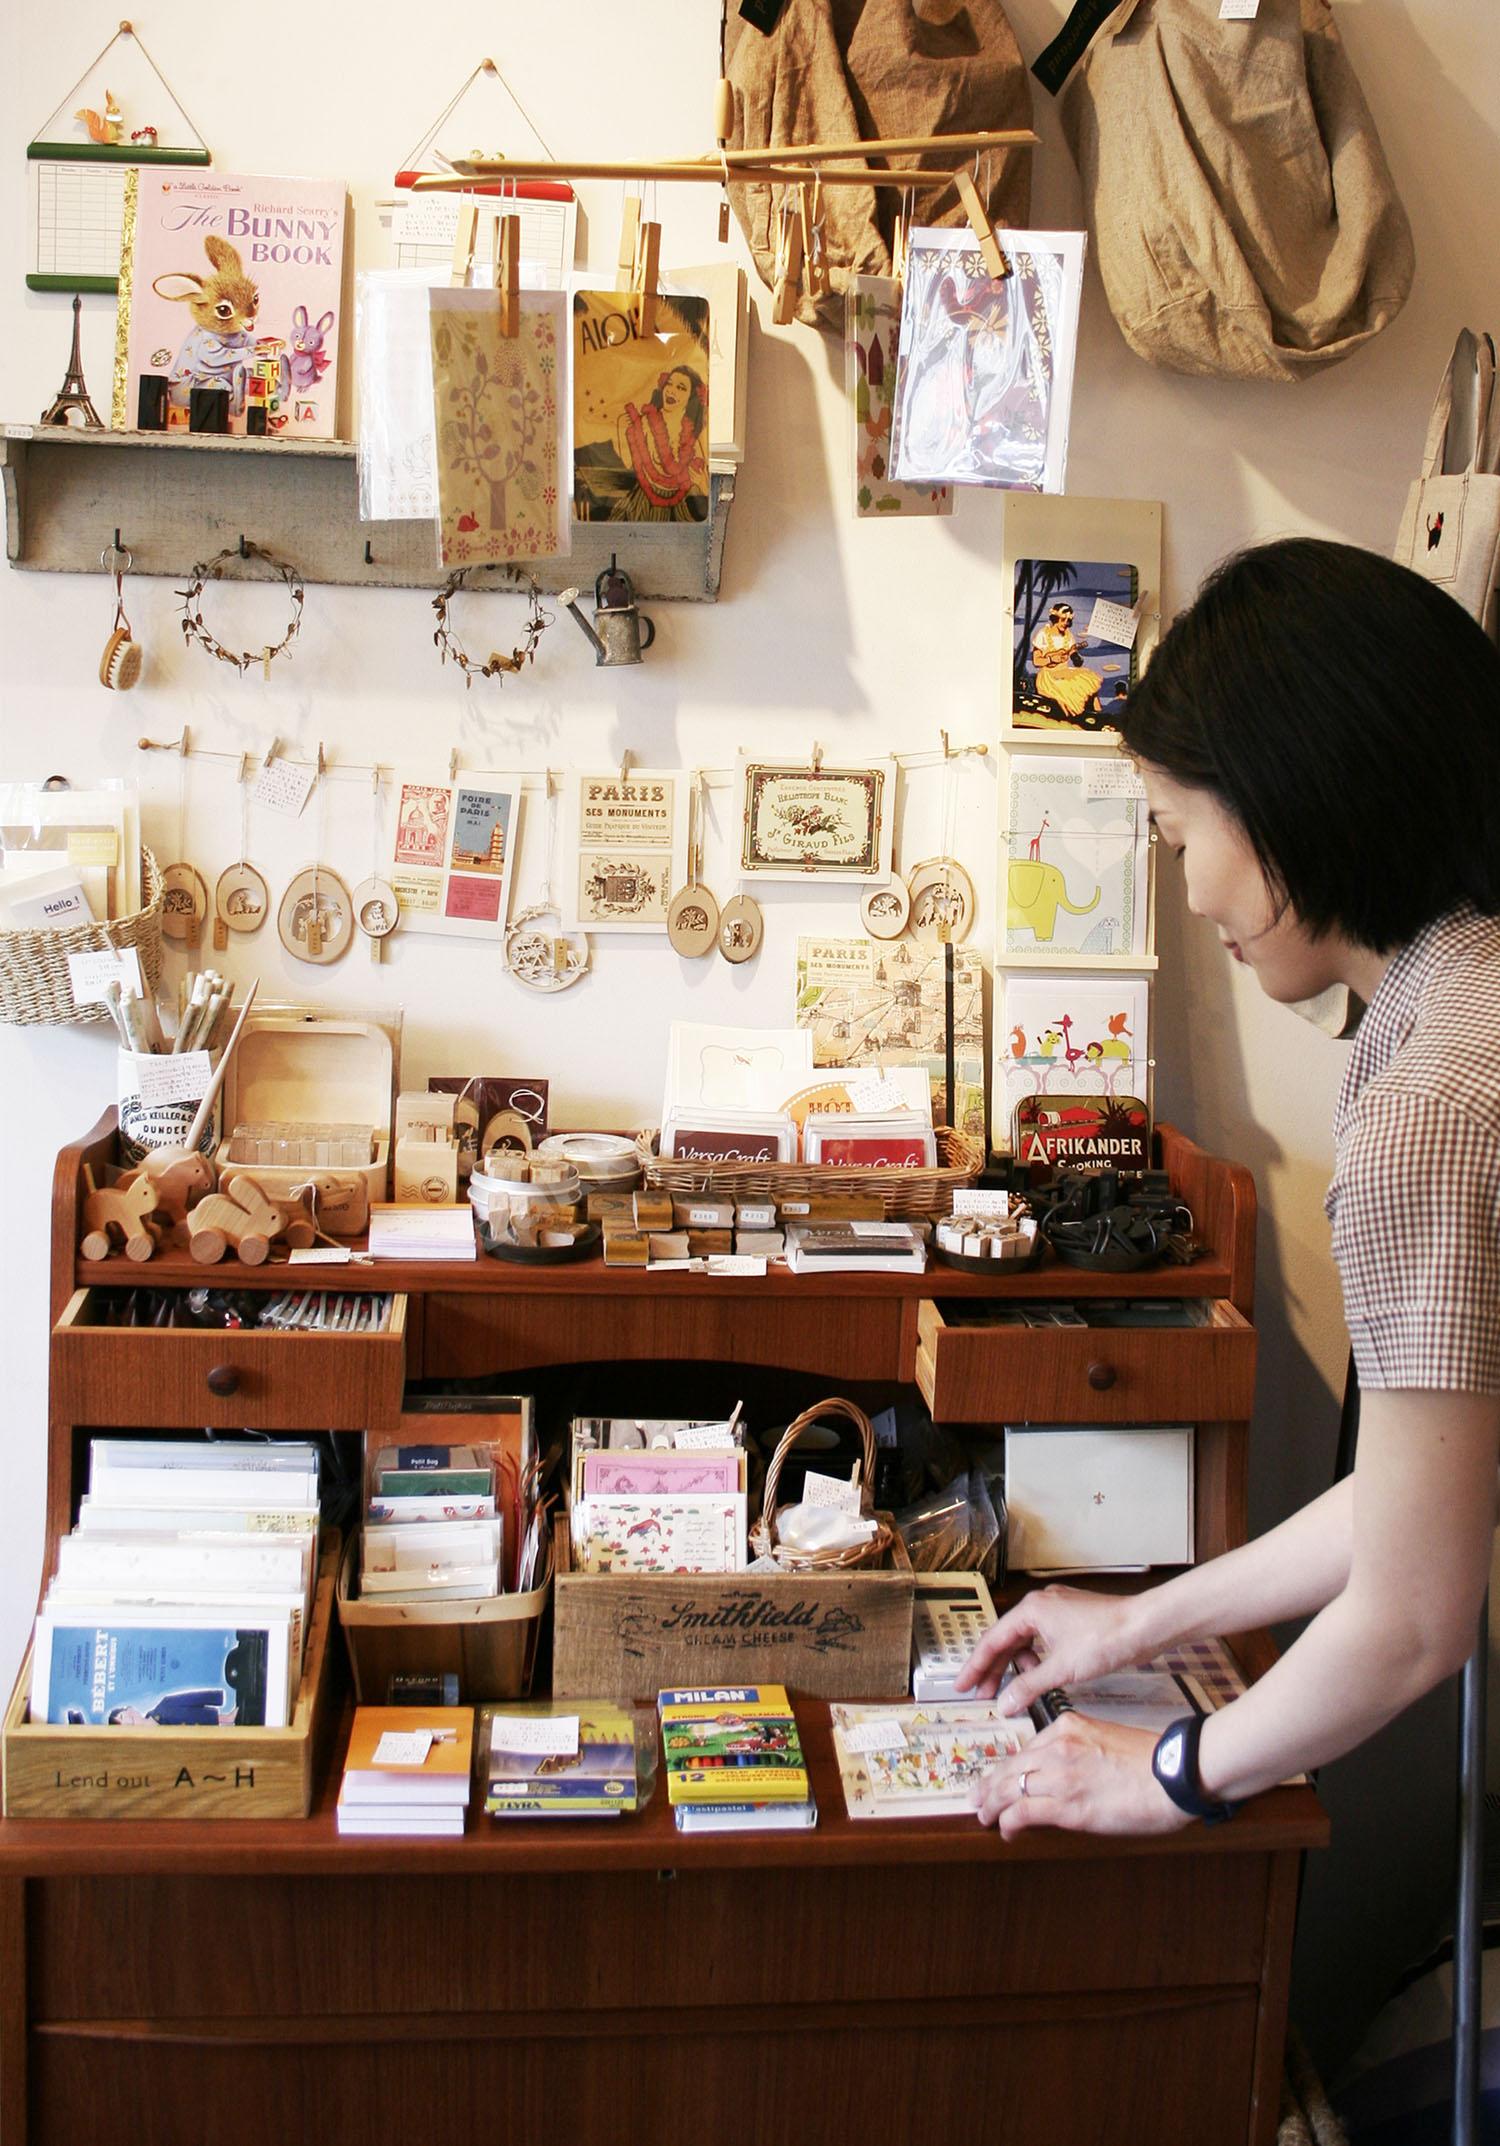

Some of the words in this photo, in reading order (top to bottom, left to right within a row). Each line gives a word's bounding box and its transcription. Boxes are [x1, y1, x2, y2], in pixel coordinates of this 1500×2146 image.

[254, 203, 294, 215] Richard
[297, 206, 338, 218] Scarry's
[161, 205, 224, 231] The
[228, 208, 337, 240] BUNNY
[252, 243, 332, 265] BOOK
[582, 307, 644, 355] ALOH
[462, 795, 492, 804] FOIRE
[587, 785, 664, 801] PARIS
[460, 808, 490, 817] PARIS
[586, 808, 603, 816] SES
[608, 808, 667, 818] MONUMENTS
[783, 833, 828, 849] GIRAUD
[832, 834, 855, 846] FILS
[43, 900, 72, 914] Hello
[812, 948, 867, 960] PARIS
[143, 1125, 187, 1135] DUNDEE
[678, 1146, 771, 1163] VersaCraft
[1027, 1132, 1142, 1165] AFRIKANDER
[1057, 1160, 1112, 1171] SOKING
[661, 1600, 819, 1629] Smithfield
[741, 1632, 796, 1646] CHEESE
[674, 1690, 746, 1703] MILAN
[56, 1771, 108, 1788] Lend
[117, 1773, 150, 1788] out
[677, 1772, 706, 1783] 12
[506, 1801, 542, 1809] LYRA
